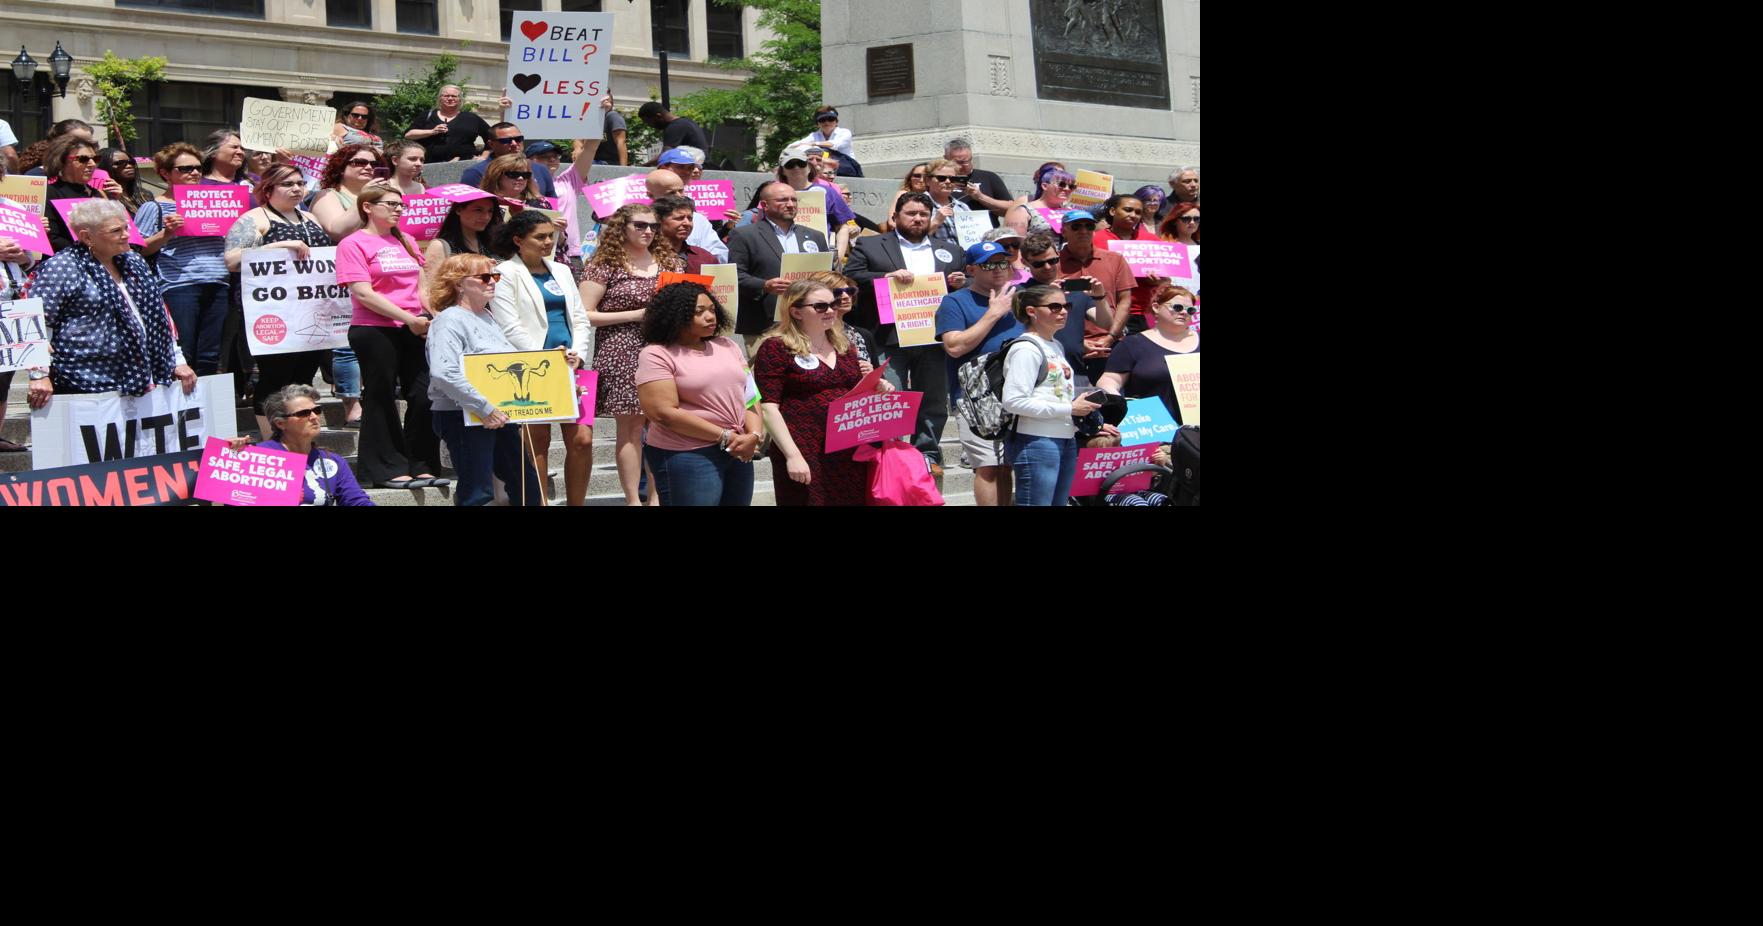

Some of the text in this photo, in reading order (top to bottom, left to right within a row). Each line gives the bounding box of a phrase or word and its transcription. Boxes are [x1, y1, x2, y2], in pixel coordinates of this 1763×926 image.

[550, 26, 603, 41] BEAT
[543, 80, 600, 96] LESS
[249, 100, 335, 123] GOVERNMENT
[246, 117, 321, 135] STAY OUT OF
[290, 134, 329, 153] BODIES
[181, 200, 243, 209] SAFE, LEGAL
[410, 198, 451, 207] PROTEC
[797, 207, 821, 215] RTION
[1124, 243, 1174, 252] PROTECT
[1150, 250, 1184, 260] LEGAL
[250, 259, 337, 276] WE WON
[784, 272, 812, 281] ABORT
[252, 284, 352, 302] GO BACK
[893, 290, 930, 299] ABORTION
[897, 311, 933, 321] ABORTION
[844, 394, 901, 411] PROTECT
[514, 409, 533, 417] TREAD
[834, 401, 910, 424] SAFE, LEGAL
[838, 410, 903, 432] ABORTION
[1138, 426, 1153, 437] My
[221, 447, 286, 467] PROTECT
[1095, 448, 1146, 461] PROTECT
[208, 456, 294, 480] SAFE, LEGAL
[1083, 461, 1116, 470] SAFE,
[0, 460, 199, 506] WOMEN'
[210, 469, 287, 491] ABORTION
